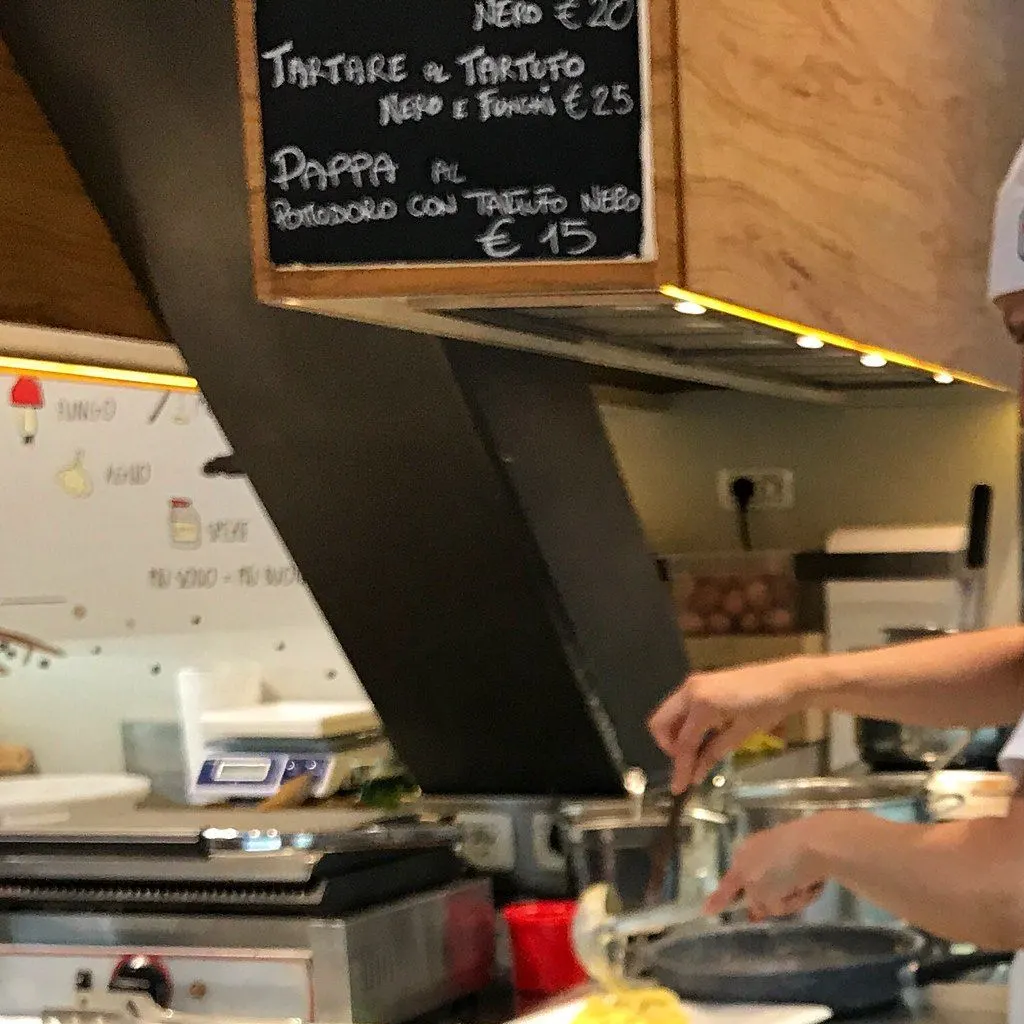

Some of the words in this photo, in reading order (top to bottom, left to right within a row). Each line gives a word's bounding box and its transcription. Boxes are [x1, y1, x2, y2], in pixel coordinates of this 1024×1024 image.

[261, 39, 408, 89] TARTARE
[455, 45, 585, 87] TARTUFO
[270, 145, 398, 192] PAPPA
